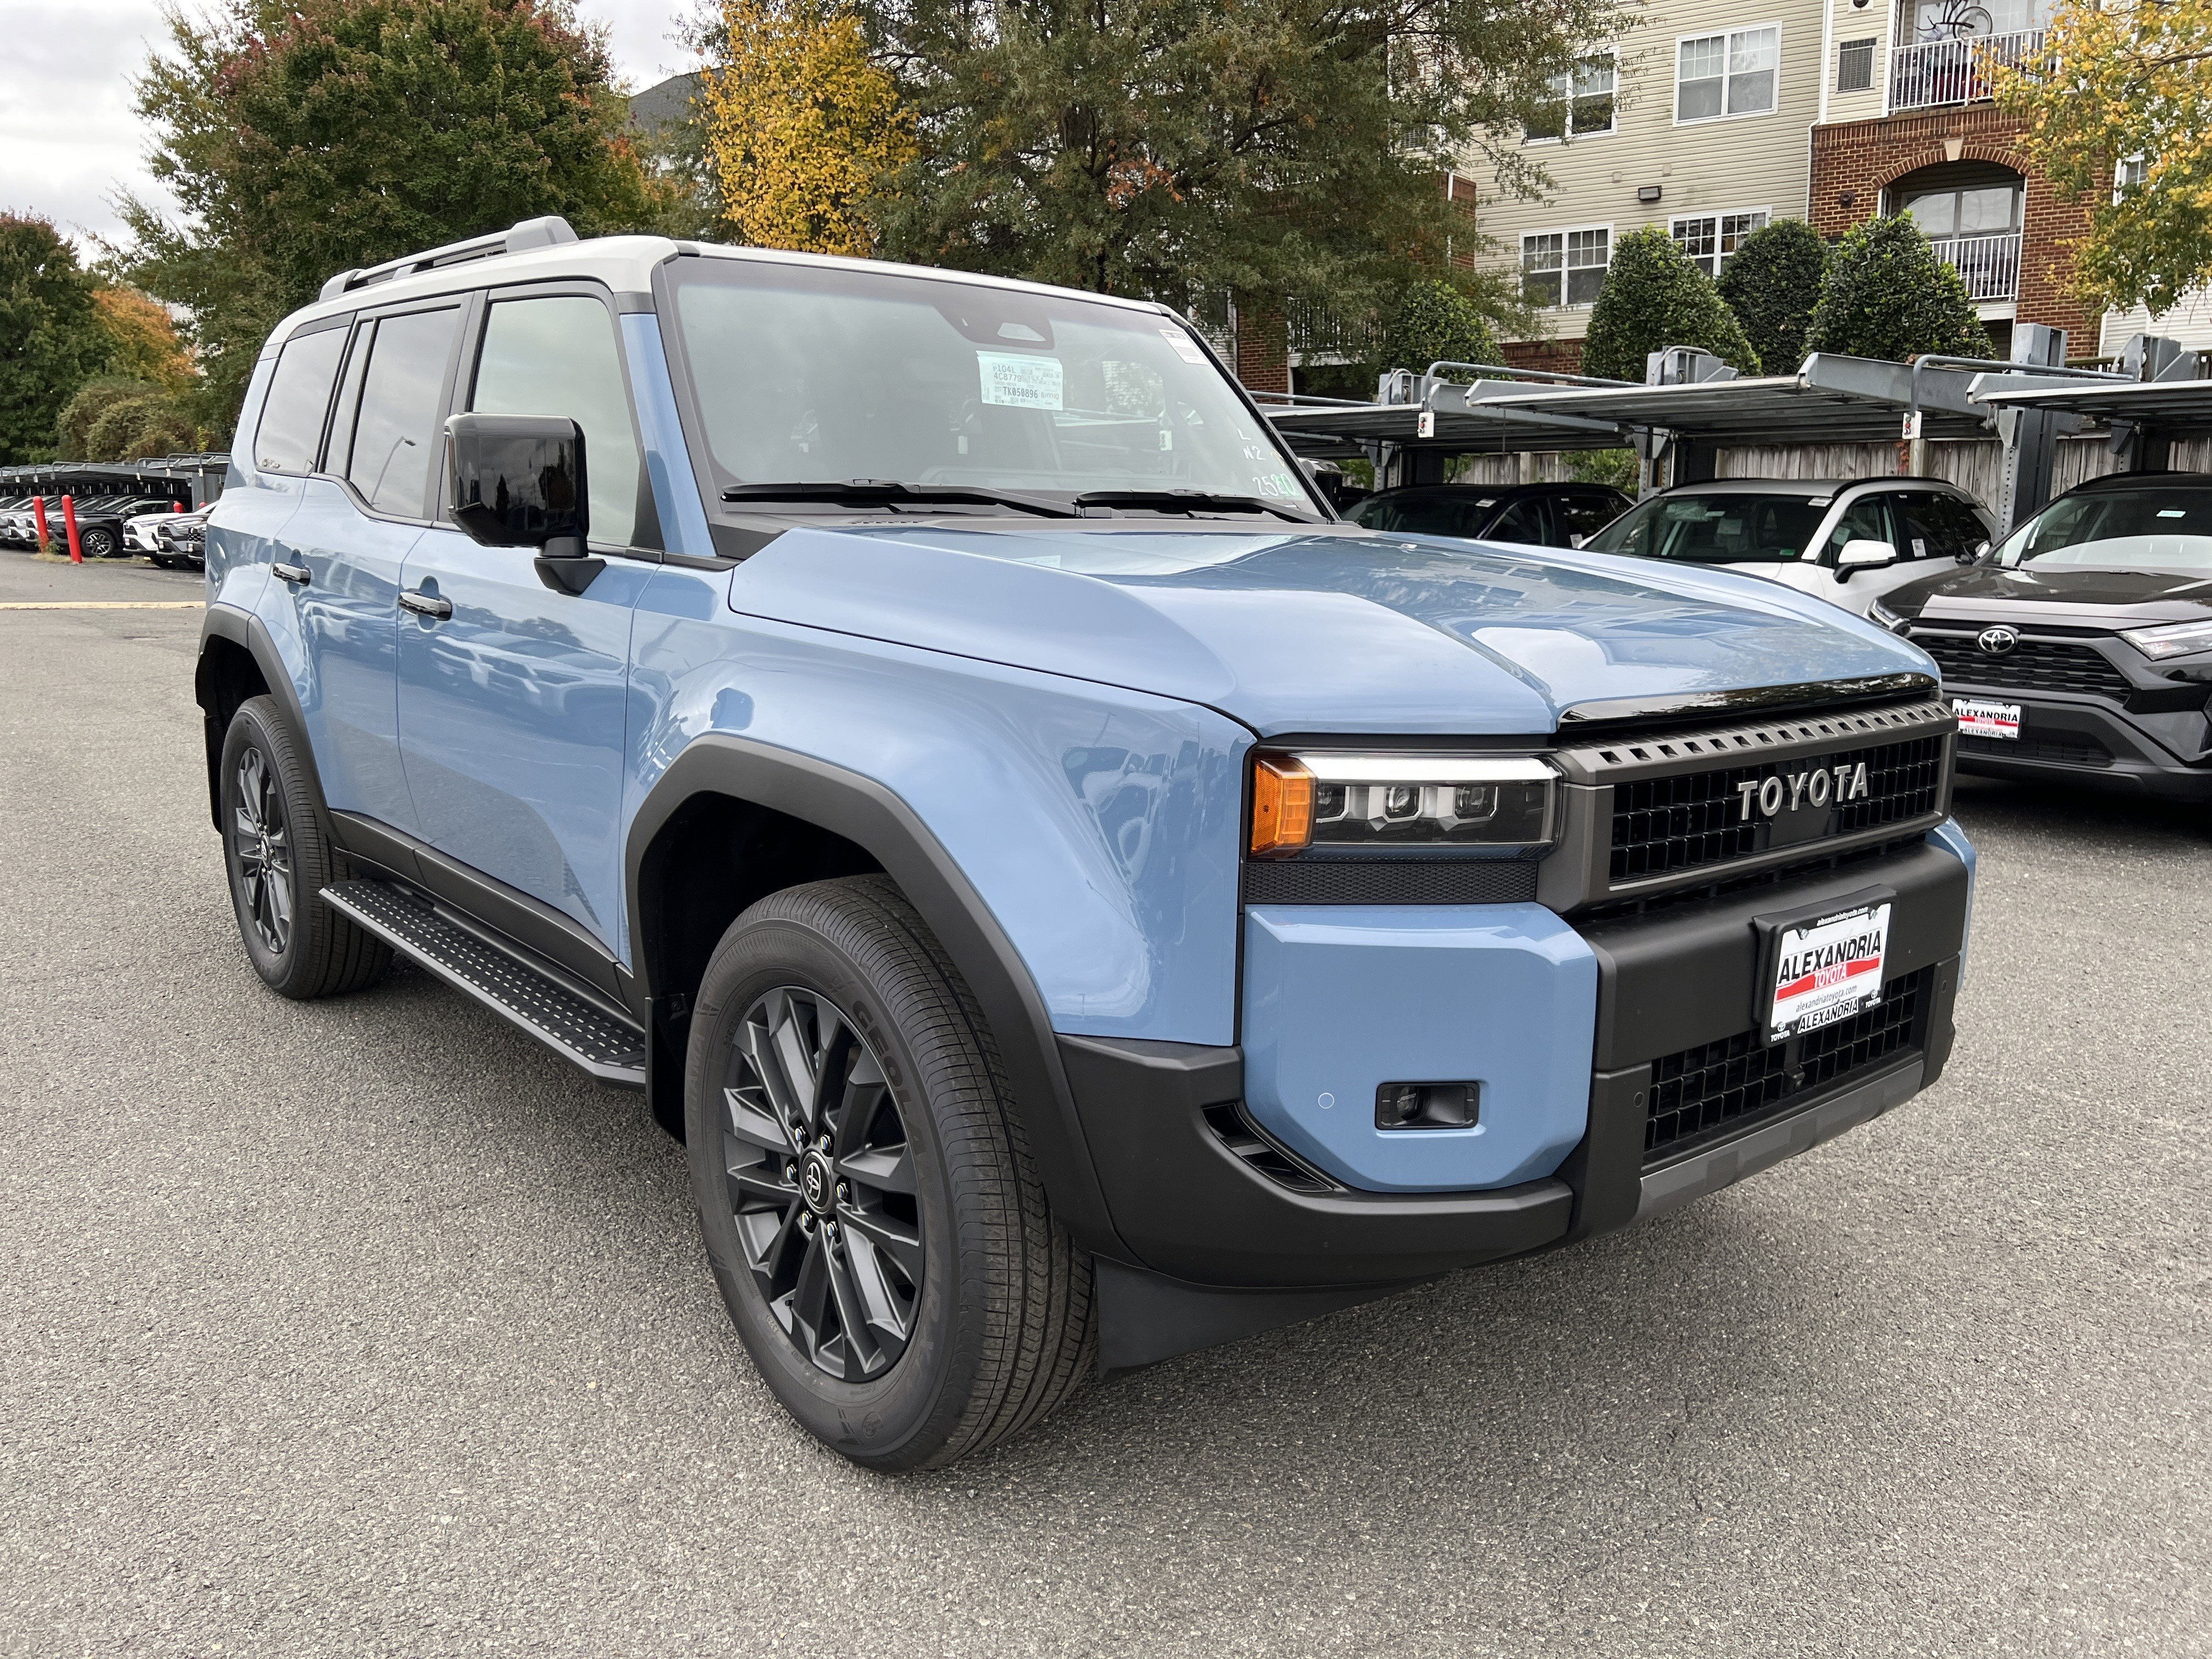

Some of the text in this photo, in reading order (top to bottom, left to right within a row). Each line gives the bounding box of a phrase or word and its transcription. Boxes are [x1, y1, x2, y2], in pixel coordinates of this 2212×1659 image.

[1003, 386, 1038, 399] TK050896
[1954, 708, 2018, 722] ALEXANDRIA
[1738, 762, 1867, 820] TOYOTA
[1779, 930, 1881, 984] ALEXANDRIA
[1814, 963, 1847, 988] TOYOTA
[1796, 985, 1858, 1013] alexandriatoyota.com
[1865, 997, 1881, 1008] TOYOTA
[1798, 998, 1858, 1034] ALEXANDRIA
[1770, 1030, 1790, 1042] TOYOTA
